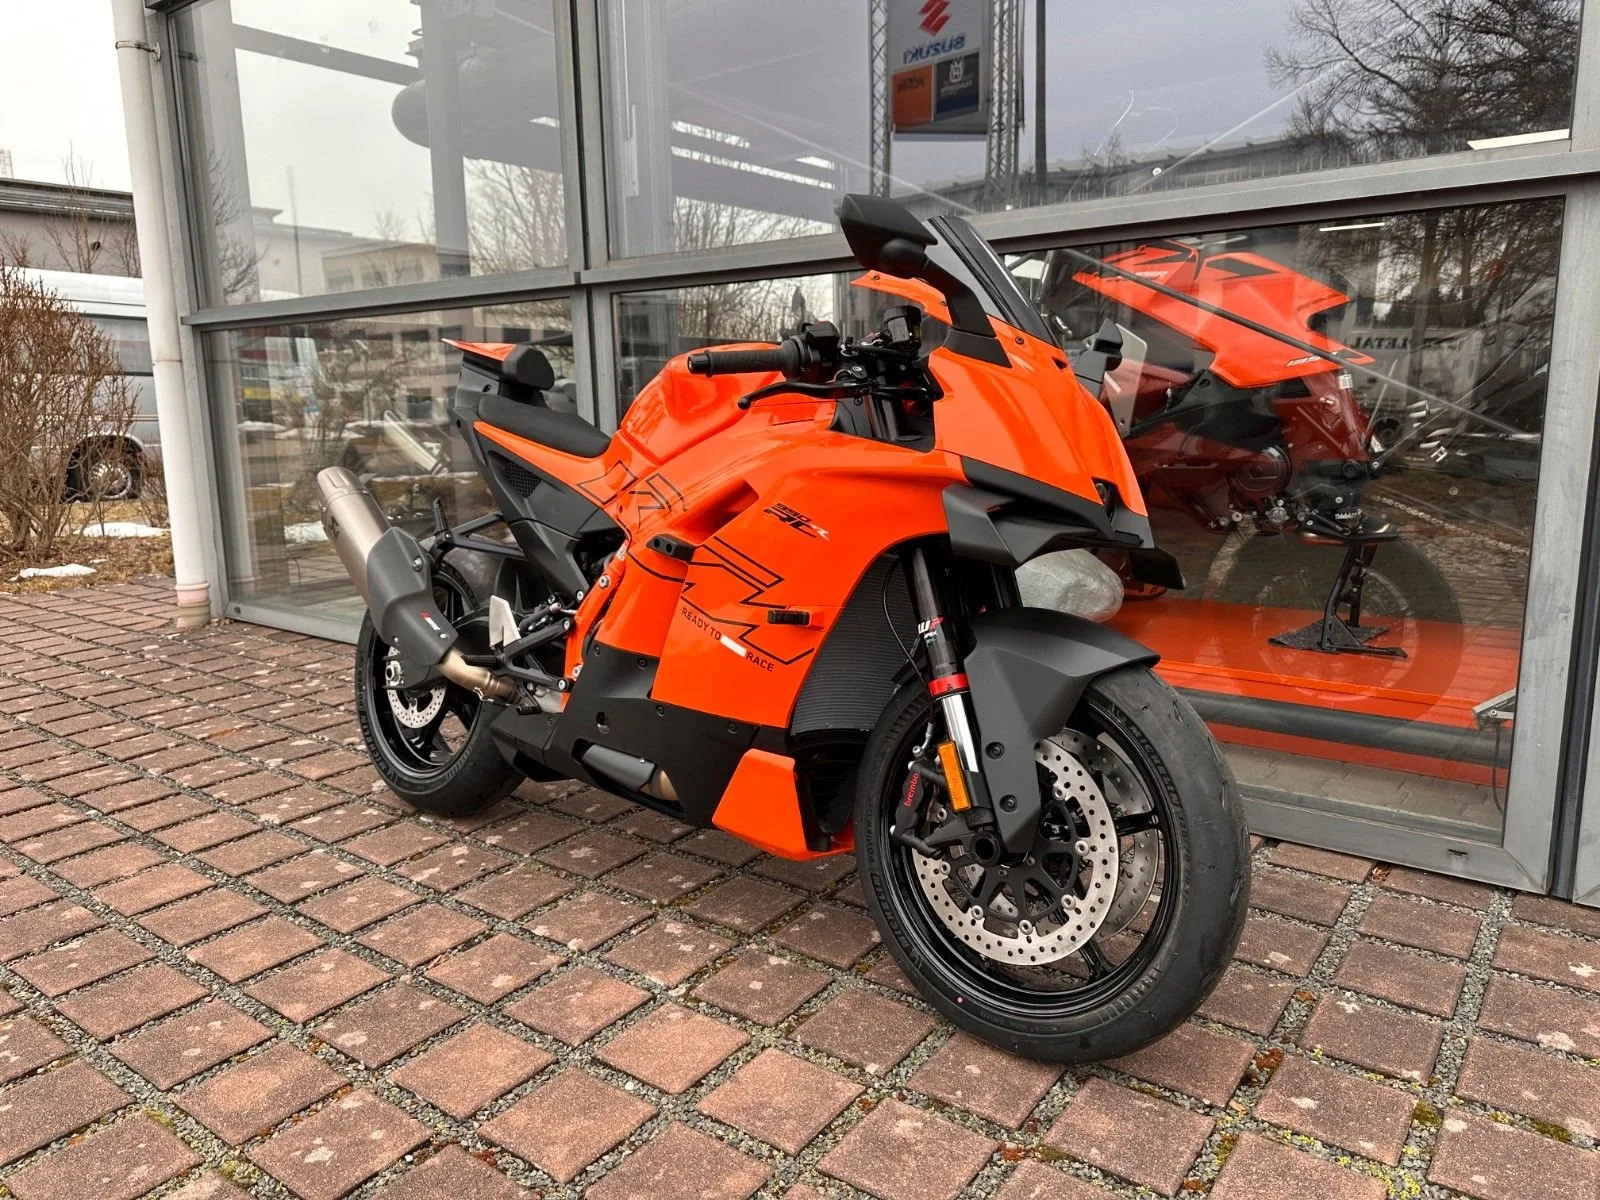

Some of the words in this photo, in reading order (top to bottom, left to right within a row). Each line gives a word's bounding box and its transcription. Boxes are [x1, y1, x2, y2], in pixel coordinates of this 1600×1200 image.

[681, 607, 709, 632] READY
[710, 622, 722, 641] TO
[745, 652, 775, 673] RACE
[904, 772, 919, 807] brembo
